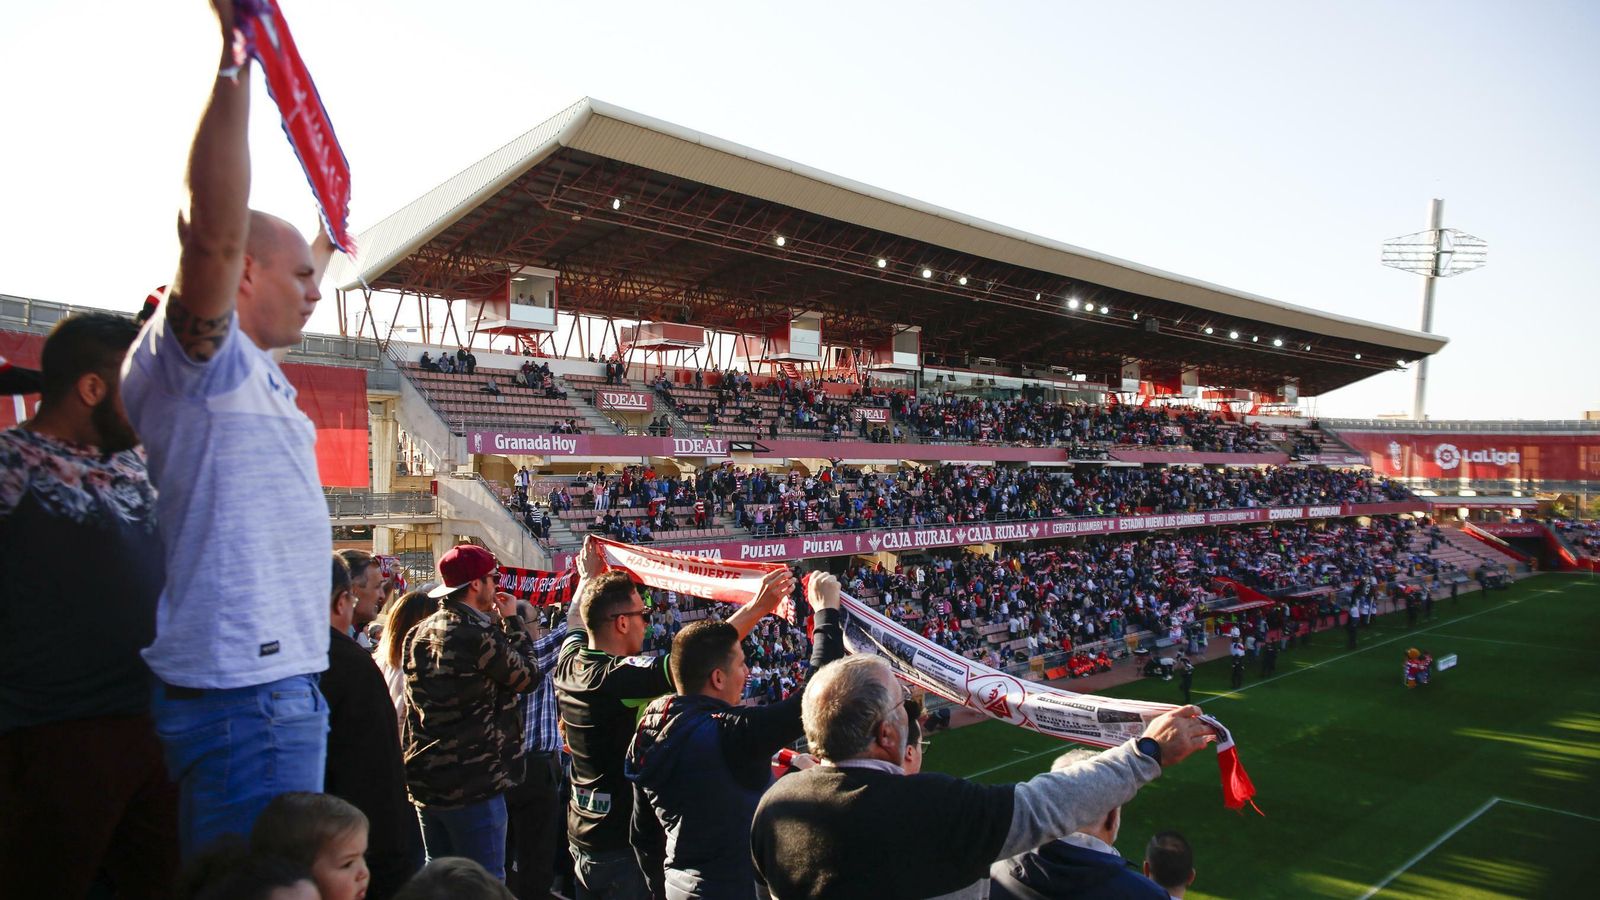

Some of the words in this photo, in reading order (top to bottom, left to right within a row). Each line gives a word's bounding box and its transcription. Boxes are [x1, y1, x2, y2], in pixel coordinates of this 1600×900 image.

[602, 392, 647, 406] IDEAL
[855, 408, 886, 420] IDEAL
[495, 434, 551, 450] Granada
[552, 436, 577, 454] Hoy
[673, 438, 727, 454] IDEAL
[1462, 448, 1520, 466] LaLiga
[1268, 508, 1303, 520] COVIRAN
[1309, 506, 1341, 517] COVIRAN
[1053, 522, 1077, 534] CERVEZAS
[1119, 518, 1144, 530] ESTADIO
[1145, 516, 1164, 528] NUEVO
[1165, 515, 1176, 527] LOS
[882, 531, 912, 549] CAJA
[914, 529, 955, 545] RURAL
[967, 526, 992, 543] CAJA
[994, 524, 1030, 540] RURAL
[741, 543, 786, 559] PULEVA
[802, 539, 843, 555] PULEVA
[688, 565, 742, 580] MUERTE
